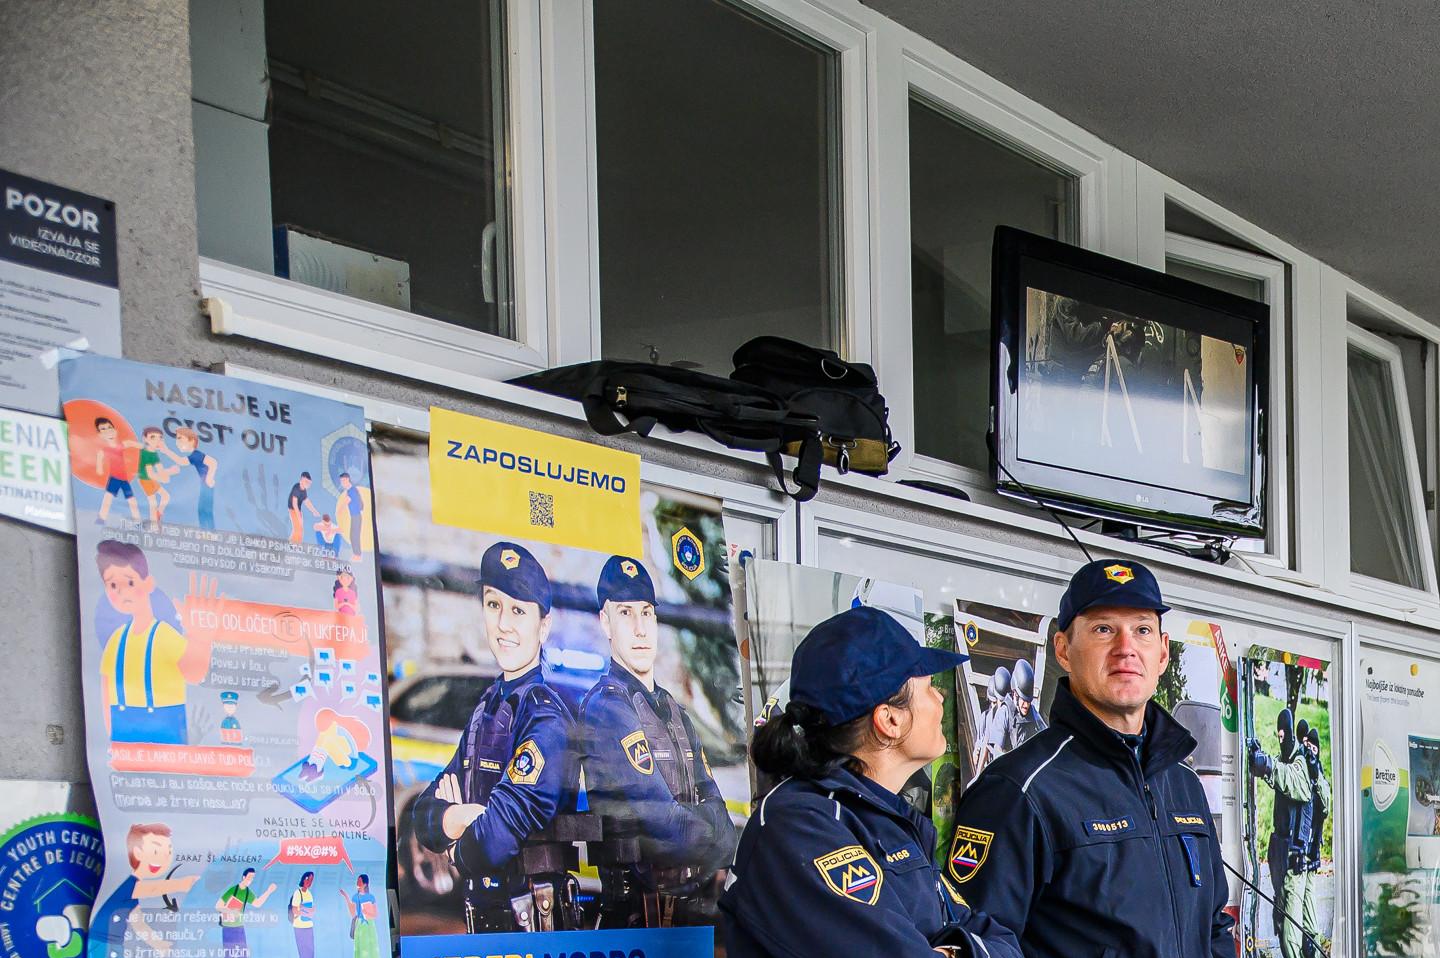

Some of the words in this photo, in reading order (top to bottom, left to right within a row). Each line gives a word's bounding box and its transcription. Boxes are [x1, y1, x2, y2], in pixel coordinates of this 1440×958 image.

[5, 186, 101, 234] POZOR
[9, 232, 102, 269] VIDEONADZOR
[38, 226, 82, 248] IZVAJA
[84, 239, 101, 255] SE
[145, 378, 260, 418] NASILJE
[265, 400, 292, 425] JE
[241, 428, 288, 456] OUT
[446, 439, 627, 494] ZAPOSLUJEMO
[0, 485, 63, 504] TINATION
[263, 816, 307, 828] NASILJE
[312, 817, 324, 828] SE
[329, 817, 361, 828] LAHKO
[1173, 815, 1205, 825] POLICIJA
[6, 829, 57, 861] YOUTH
[255, 828, 296, 839] DOGAJA
[301, 829, 325, 840] TUDI
[331, 829, 371, 842] ONLINE.
[957, 829, 988, 842] POLICIJA
[821, 849, 864, 869] POLICIJA
[0, 855, 43, 911] CENTRE
[44, 848, 64, 866] DE
